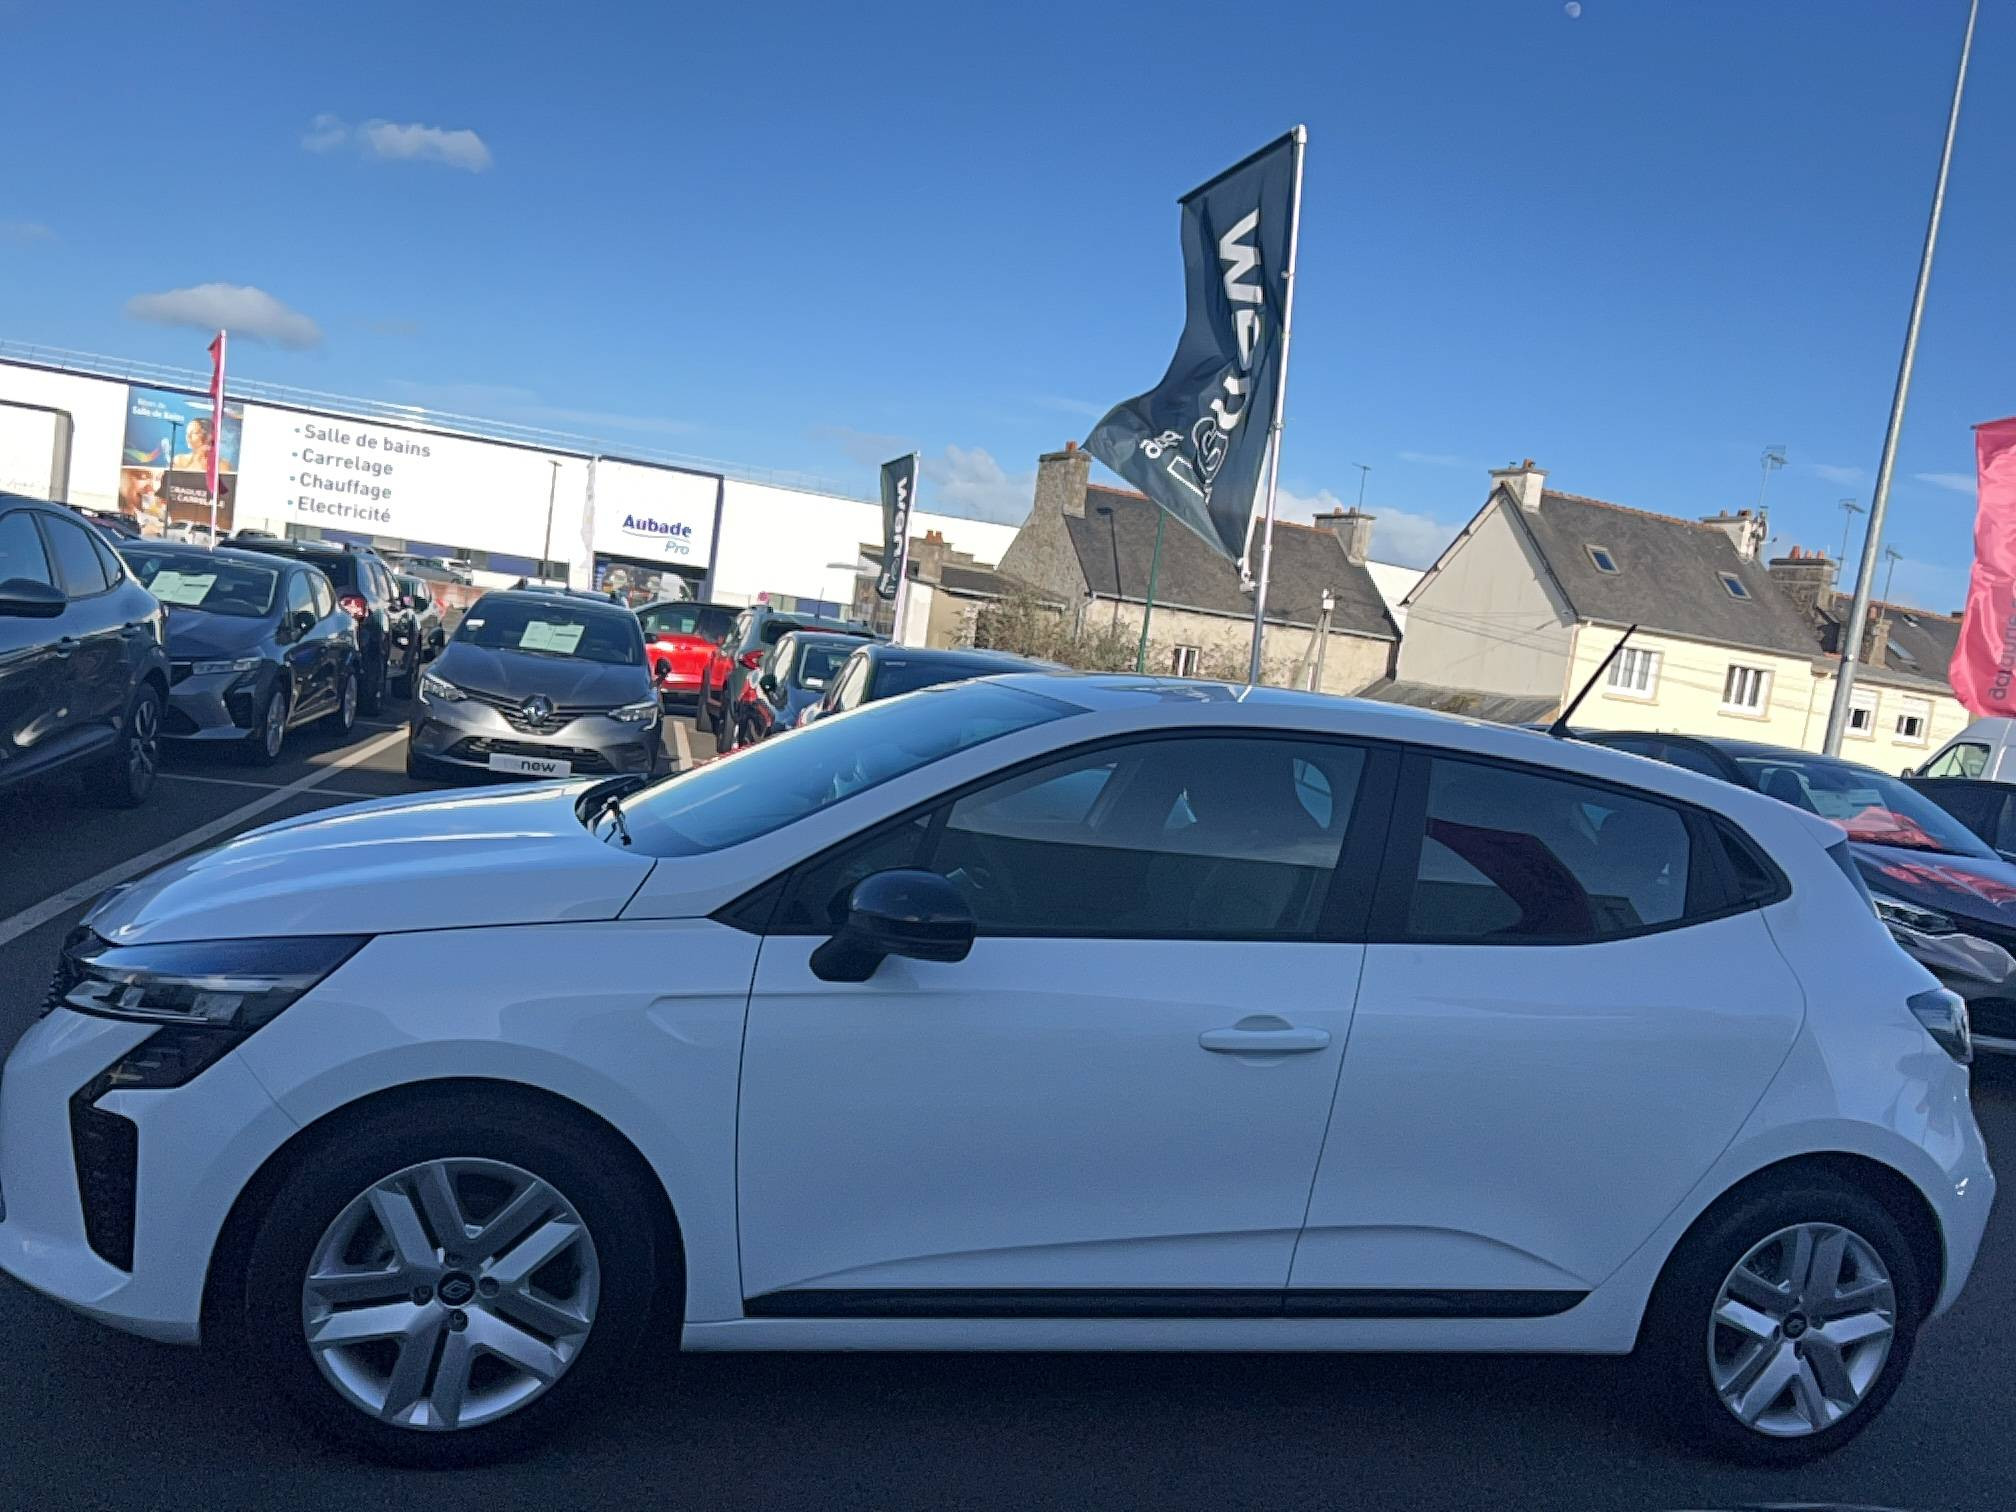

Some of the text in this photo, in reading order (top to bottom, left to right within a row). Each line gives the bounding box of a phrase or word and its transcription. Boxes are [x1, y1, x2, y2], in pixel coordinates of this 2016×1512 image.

[304, 423, 431, 457] Salle de bains
[302, 447, 393, 477] Carrelage
[299, 471, 392, 501] Chauffage
[297, 495, 392, 523] Electricité
[622, 514, 692, 538] Aubade
[664, 540, 690, 555] Pro
